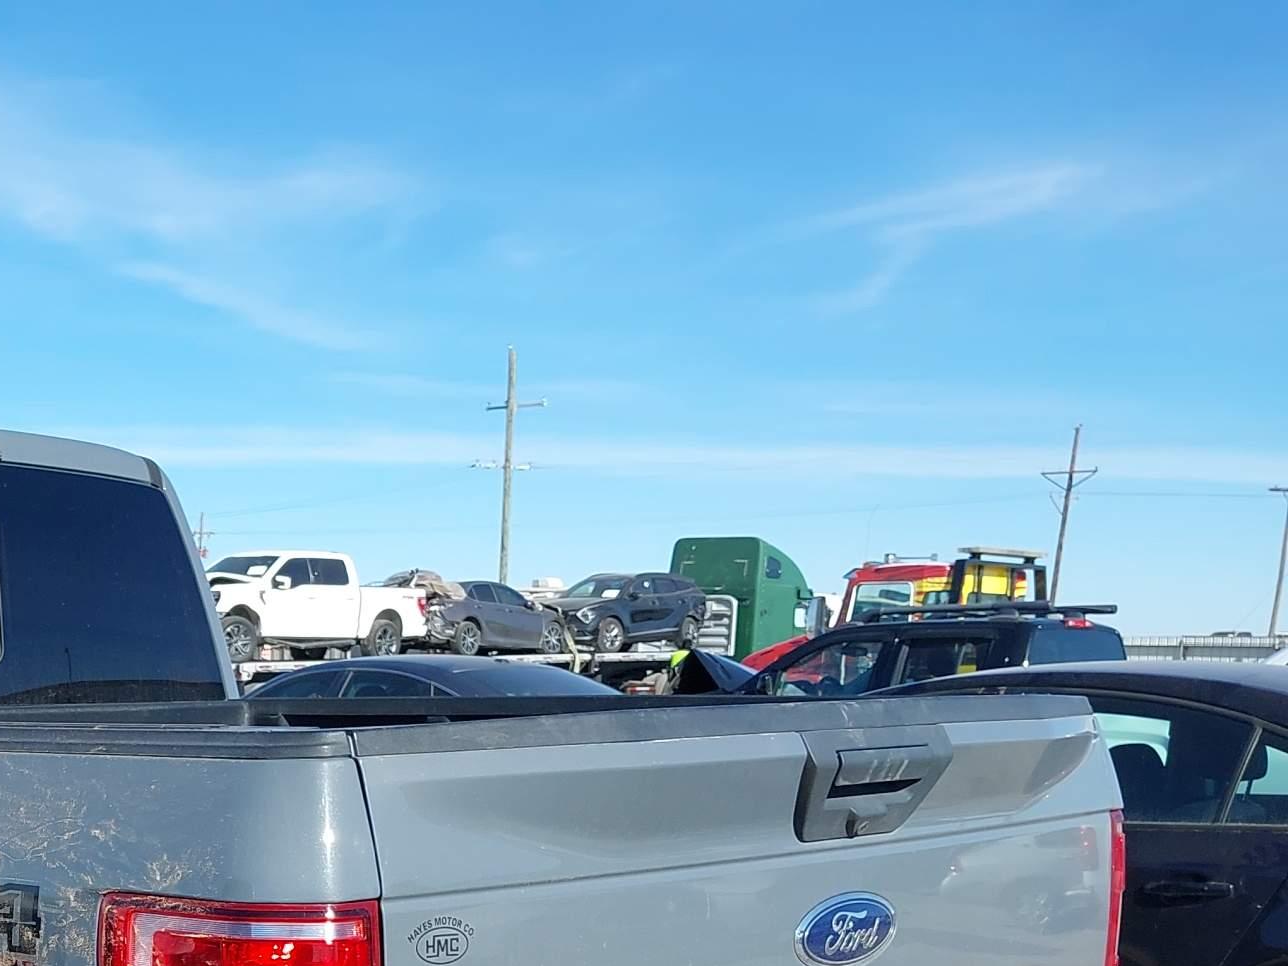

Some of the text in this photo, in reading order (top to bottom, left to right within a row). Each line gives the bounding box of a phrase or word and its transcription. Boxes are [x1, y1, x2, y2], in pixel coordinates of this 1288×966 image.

[407, 919, 433, 943] HAYES
[434, 916, 463, 928] MOTOR
[824, 909, 881, 956] Ford
[425, 933, 460, 958] HMC
